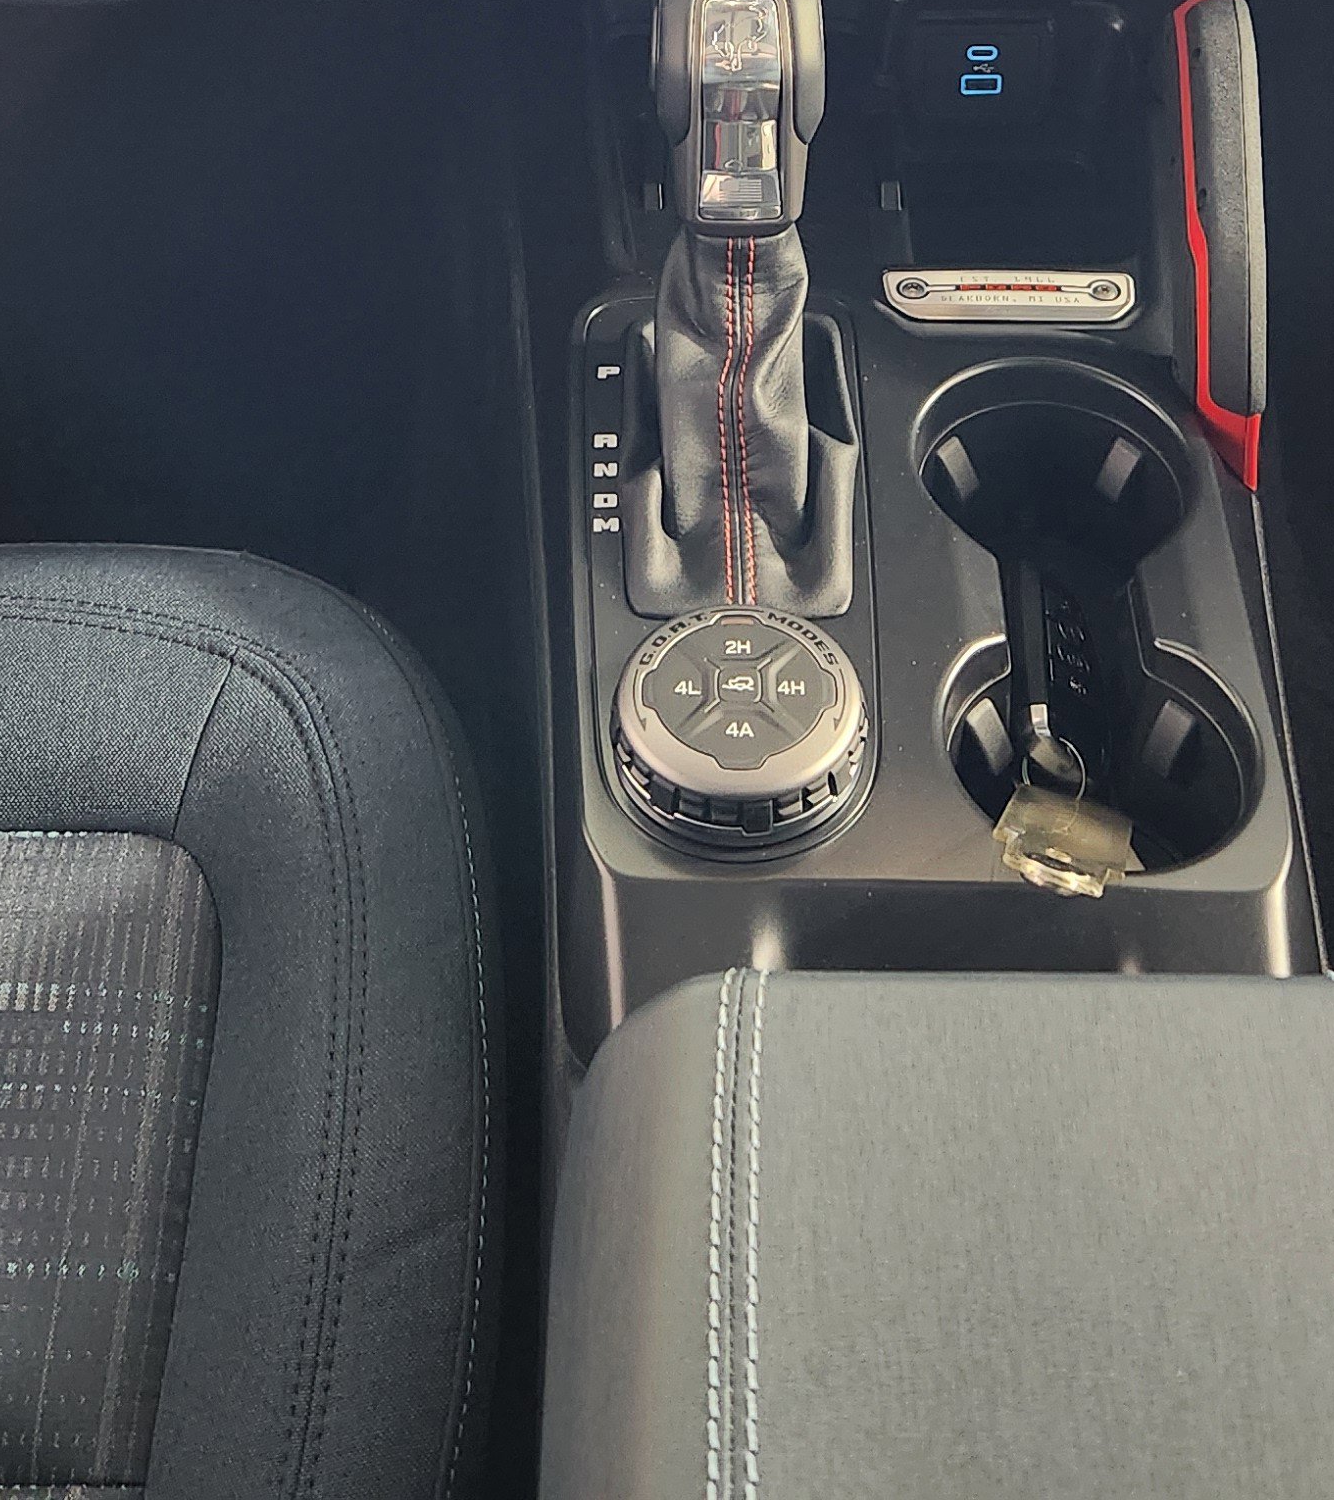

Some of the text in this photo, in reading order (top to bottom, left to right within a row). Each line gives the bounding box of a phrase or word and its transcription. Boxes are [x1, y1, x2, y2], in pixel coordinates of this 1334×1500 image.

[596, 365, 621, 380] P
[593, 432, 618, 449] R
[593, 461, 619, 478] N
[593, 492, 619, 509] D
[593, 515, 621, 533] M
[767, 612, 839, 666] MODES
[725, 640, 751, 655] 2H
[674, 680, 702, 695] 4L
[777, 680, 805, 696] 4H
[725, 722, 755, 738] 4A
